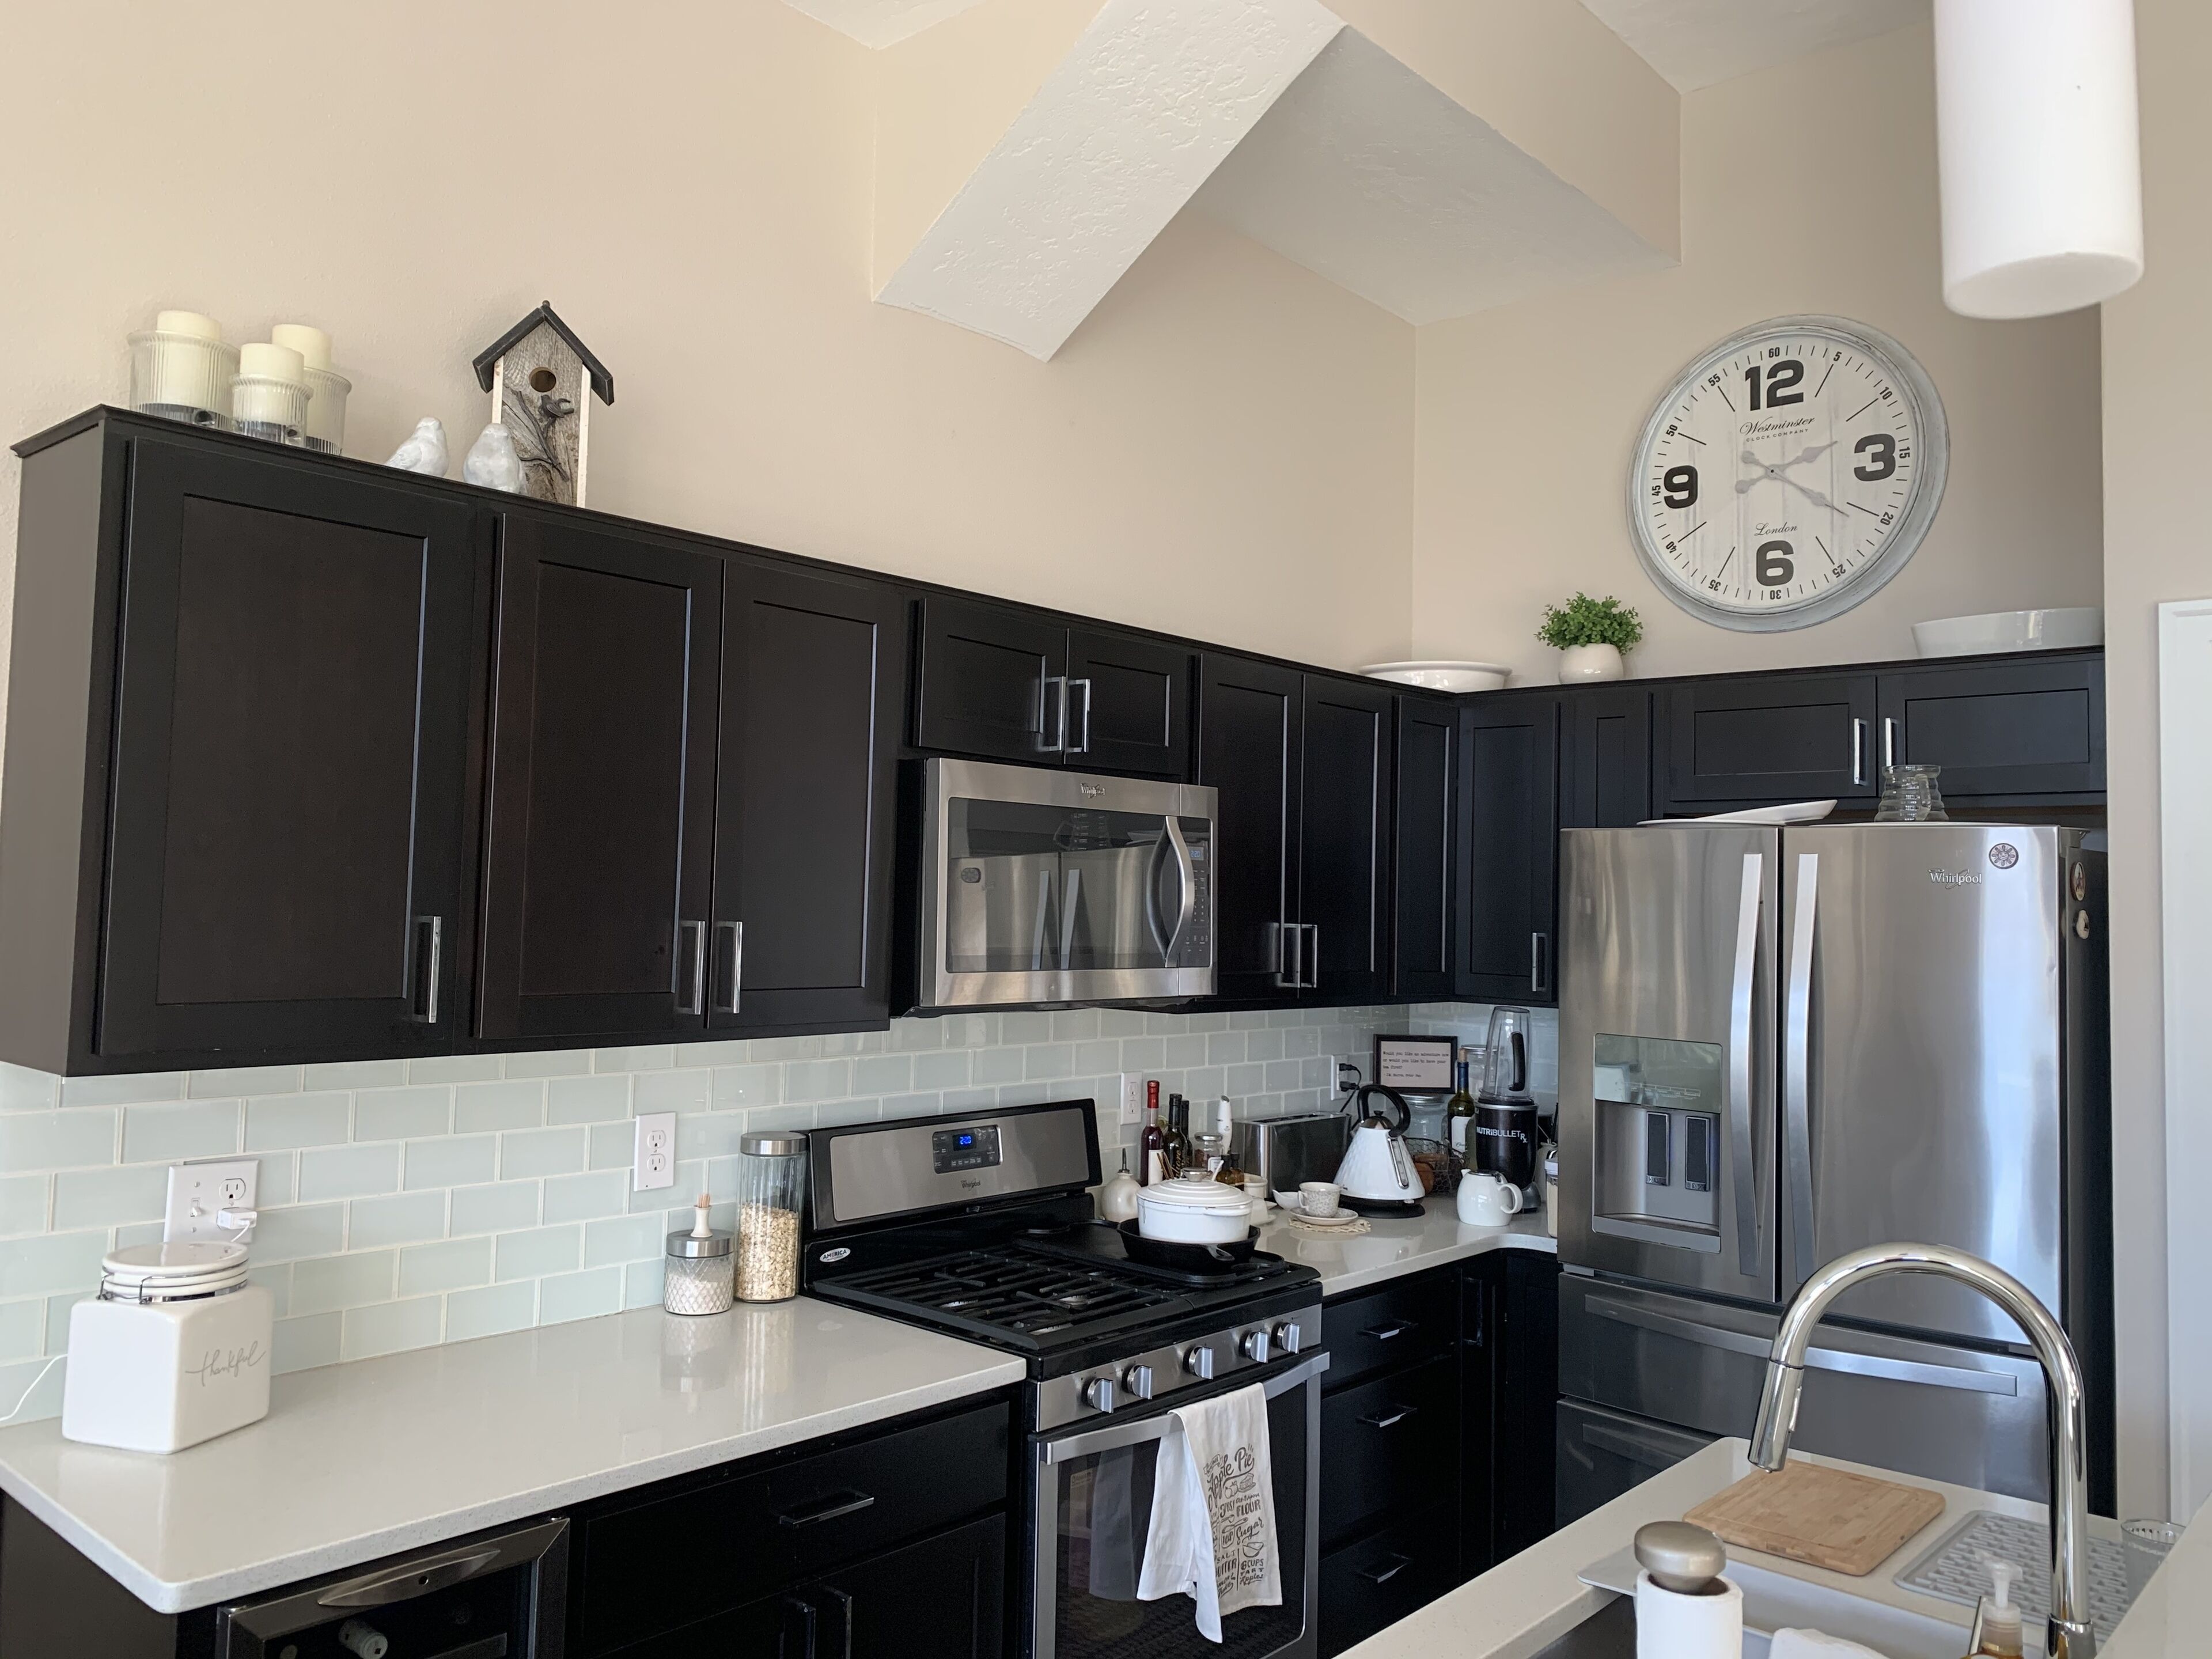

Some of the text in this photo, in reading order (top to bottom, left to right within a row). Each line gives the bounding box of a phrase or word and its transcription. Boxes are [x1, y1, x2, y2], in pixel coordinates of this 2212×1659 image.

[1768, 347, 1780, 358] 60
[1833, 351, 1842, 362] 5
[1707, 373, 1721, 387] 55
[1745, 359, 1804, 411] 12
[1879, 387, 1893, 400] 10
[1665, 424, 1678, 437] 50
[1740, 416, 1816, 436] Westminster
[1746, 428, 1809, 442] CLOCK COMPANY
[1854, 433, 1896, 482] 3
[1899, 446, 1911, 459] 15
[1652, 484, 1661, 497] 45
[1664, 465, 1698, 509] 9
[1880, 511, 1894, 526] 20
[1753, 521, 1798, 536] London
[1665, 540, 1677, 554] 40
[1756, 540, 1794, 586] 6
[1832, 563, 1846, 578] 25
[1708, 579, 1722, 592] 35
[1770, 589, 1782, 600] 30
[1929, 870, 1982, 887] Whirlpool
[823, 1249, 847, 1260] AMERICA
[184, 1340, 267, 1387] thankful
[1207, 1454, 1234, 1512] Apple
[1234, 1446, 1255, 1472] Pie
[1236, 1499, 1261, 1517] FLOUR
[1236, 1517, 1264, 1546] Sugar
[1217, 1549, 1236, 1565] SALT
[1240, 1574, 1264, 1586] Apples
